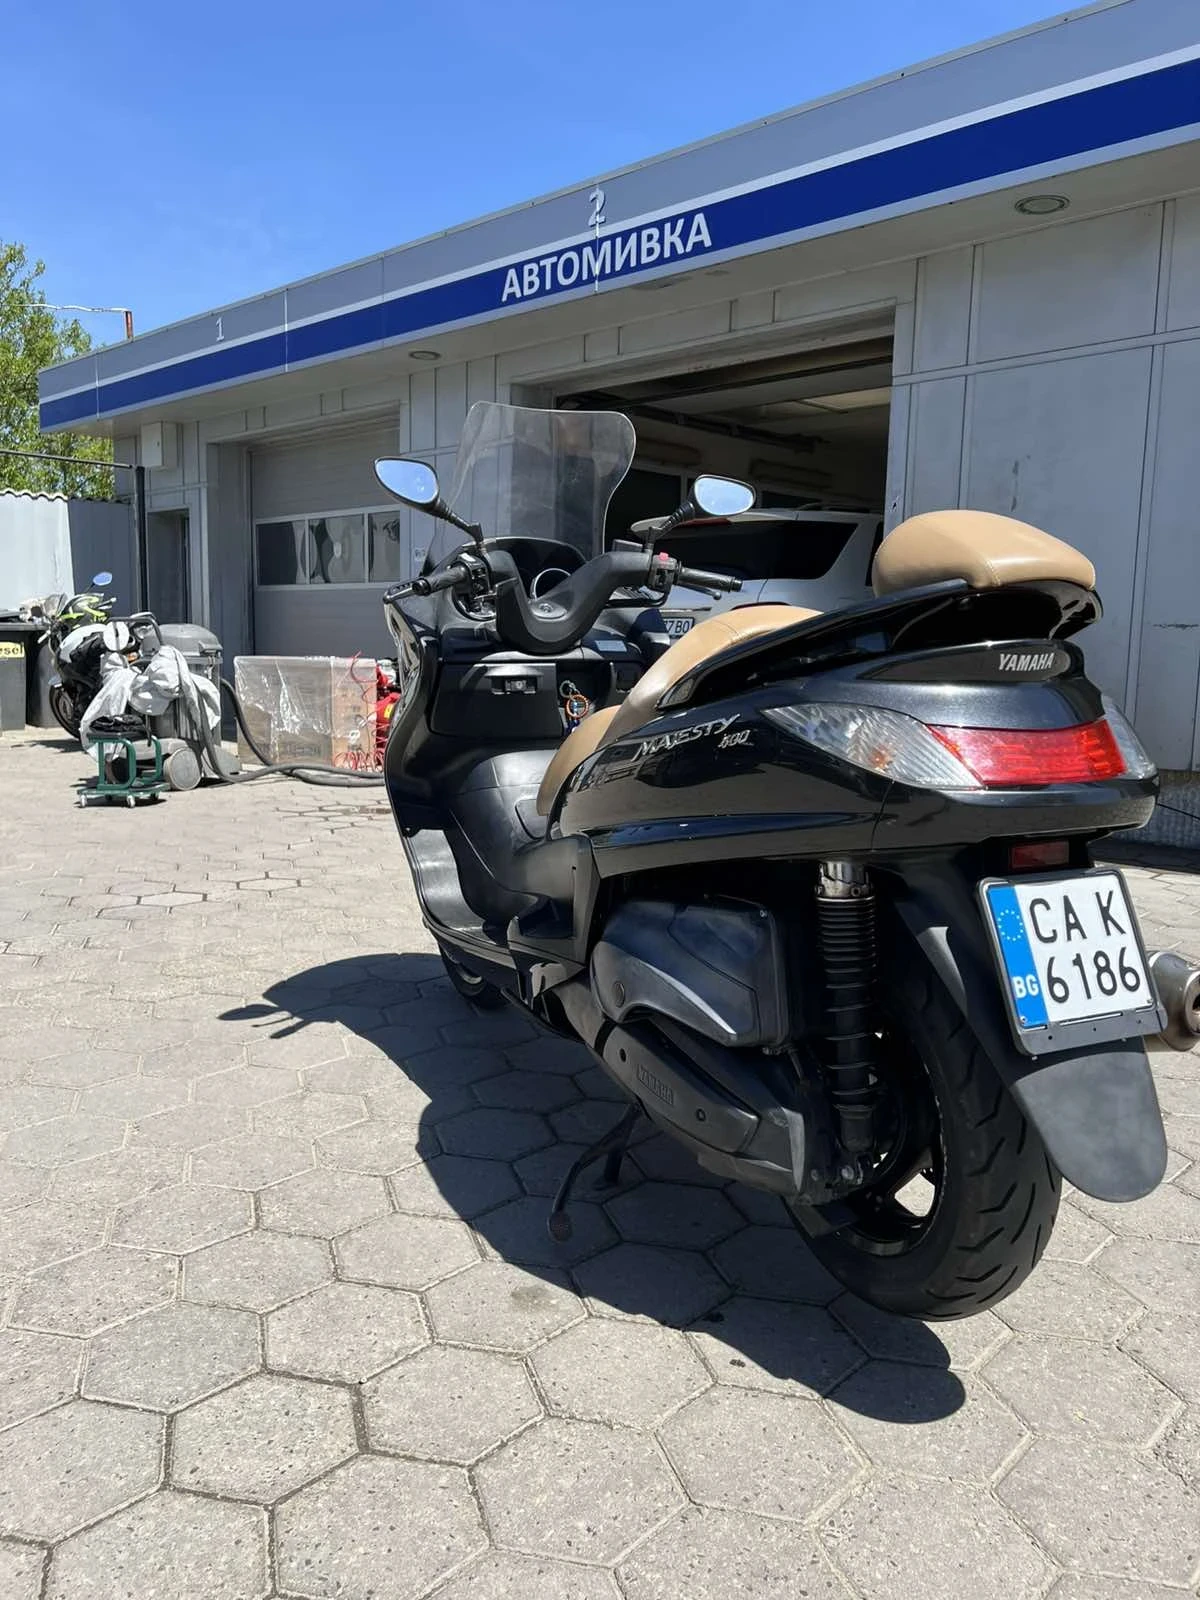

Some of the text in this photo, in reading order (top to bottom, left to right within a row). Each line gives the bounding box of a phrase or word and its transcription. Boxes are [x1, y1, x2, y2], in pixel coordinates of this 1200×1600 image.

[588, 187, 606, 227] 2
[501, 212, 712, 302] АВТОМИВКА
[215, 317, 225, 342] 1
[998, 652, 1055, 672] YAMAHA
[630, 713, 741, 762] MAJESTY
[1012, 974, 1040, 999] BG
[1046, 946, 1141, 1004] 6186
